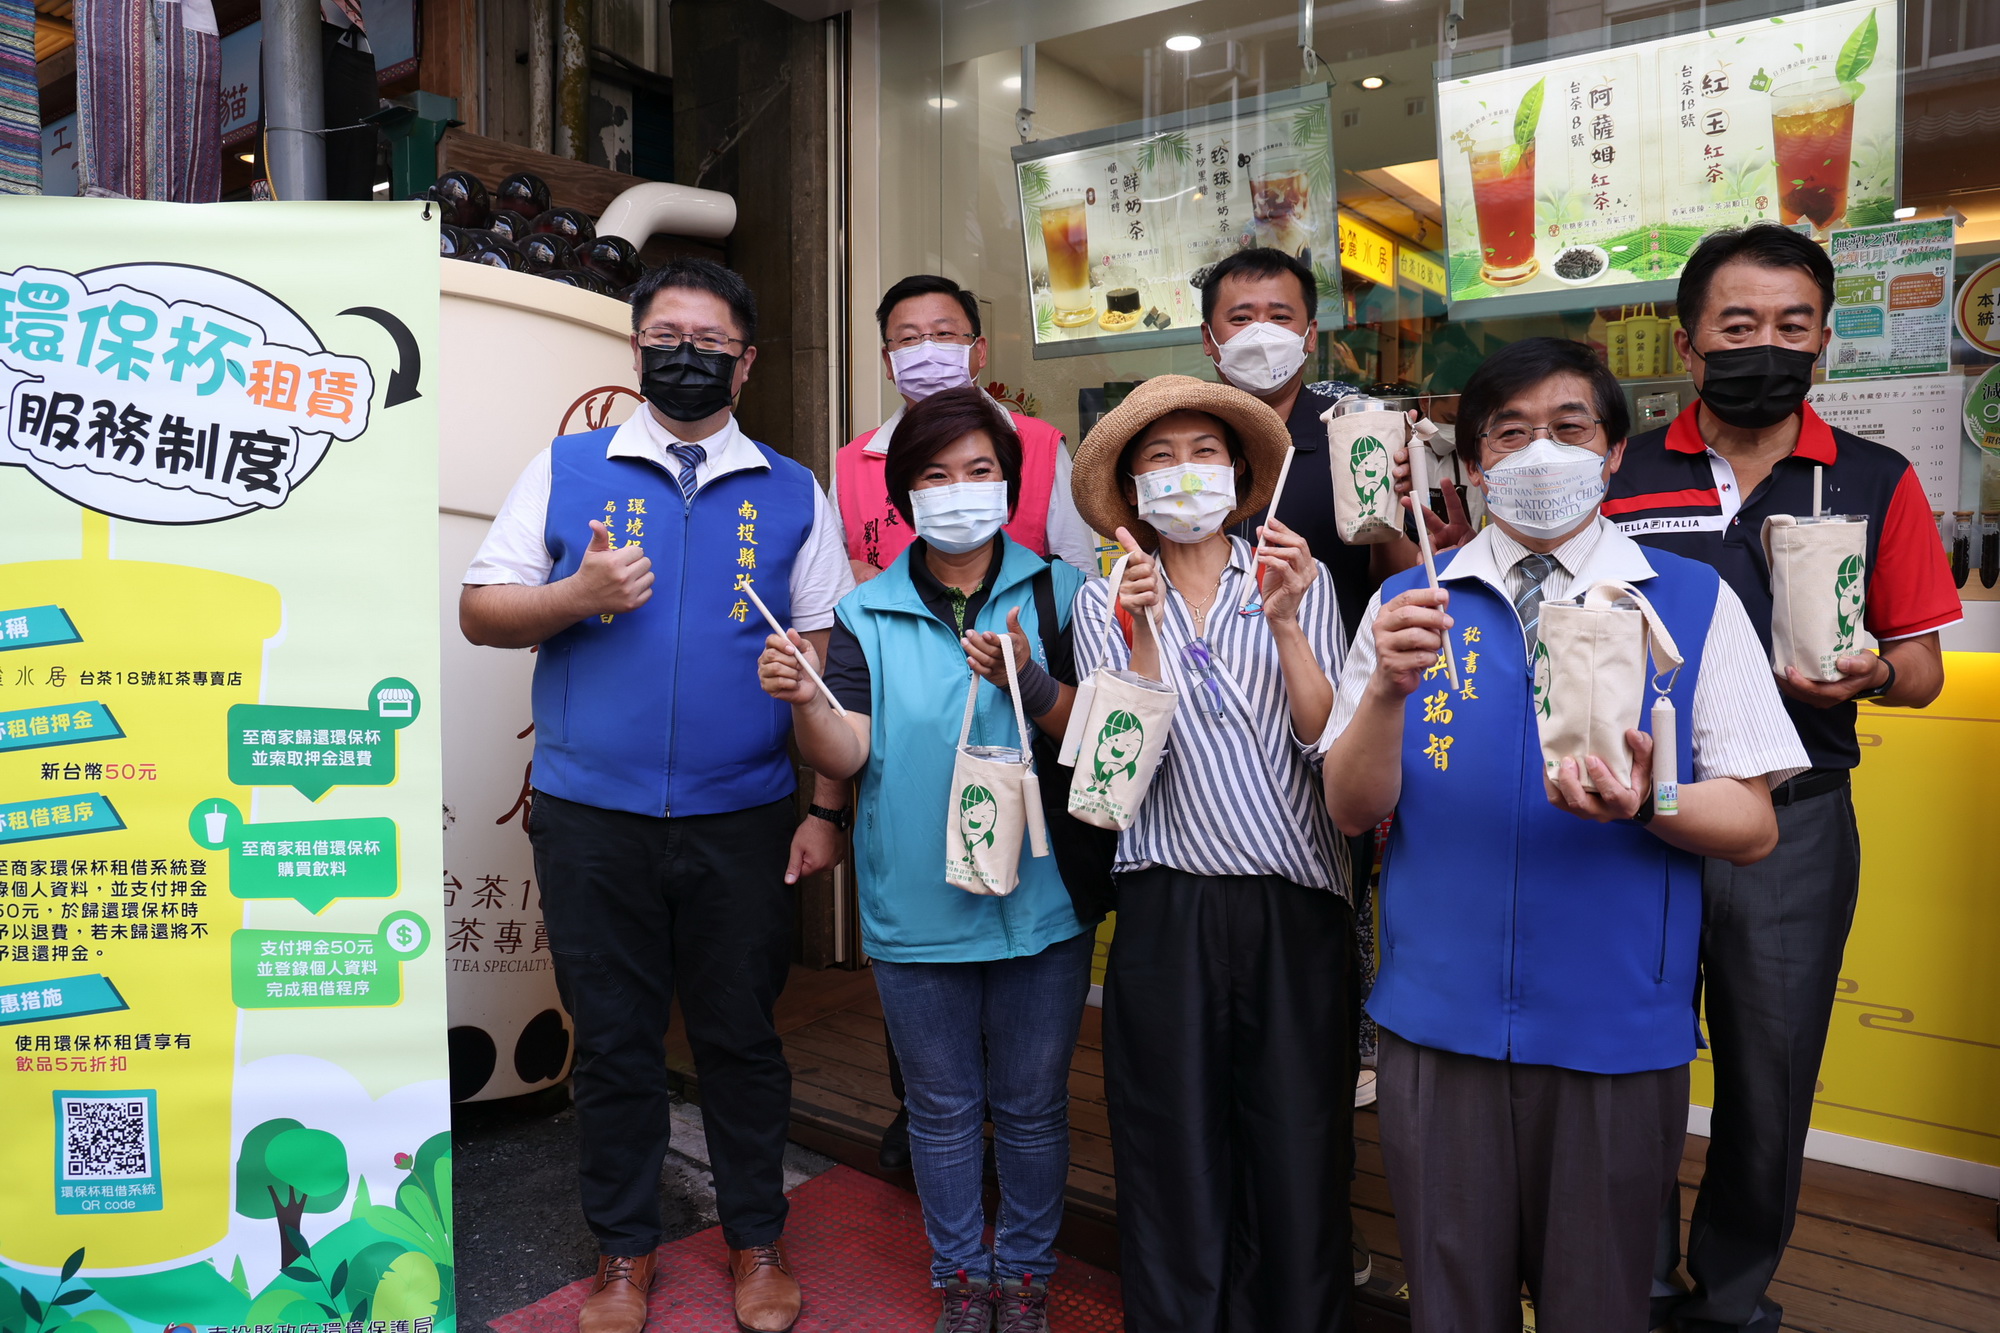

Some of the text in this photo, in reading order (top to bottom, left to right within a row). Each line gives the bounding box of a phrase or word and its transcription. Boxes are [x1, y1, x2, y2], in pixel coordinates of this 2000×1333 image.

[1681, 65, 1696, 128] 台茶18號
[1570, 81, 1585, 148] 台茶8號
[1701, 75, 1729, 184] 紅玉紅茶
[1588, 87, 1616, 211] 阿薩姆紅茶
[1211, 147, 1232, 233] 珍珠鮮奶茶
[1122, 172, 1144, 240] 鮮奶茶
[1977, 293, 2000, 308] 本
[1977, 311, 2000, 327] 統
[0, 280, 360, 426] 環保杯租賃
[18, 391, 291, 495] 服務制度
[1515, 494, 1575, 510] NATIONAL
[1575, 488, 1593, 501] CHI
[1515, 503, 1582, 521] UNIVERSITY
[1661, 519, 1700, 528] ITALIA
[728, 500, 759, 623] 南投縣政府
[1459, 626, 1482, 700] 秘書長
[80, 671, 242, 686] 台茶18號紅茶專賣店
[242, 729, 381, 746] 至商家歸還環保杯
[252, 750, 372, 767] 並索取押金退費
[41, 762, 157, 781] 新台幣50元
[242, 840, 381, 857] 至商家租借環保杯
[277, 861, 347, 877] 購買飲料
[261, 940, 374, 956] 支付押金50元
[257, 960, 378, 977] 並登錄個人資料
[453, 958, 549, 973] TEA SPECIALTY
[266, 981, 370, 997] 完成租借程序
[15, 1033, 191, 1051] 使用環保杯租賃享有
[16, 1056, 127, 1072] 飲品5元折扣
[61, 1184, 156, 1198] 環保杯租借系統
[82, 1200, 136, 1211] QR code
